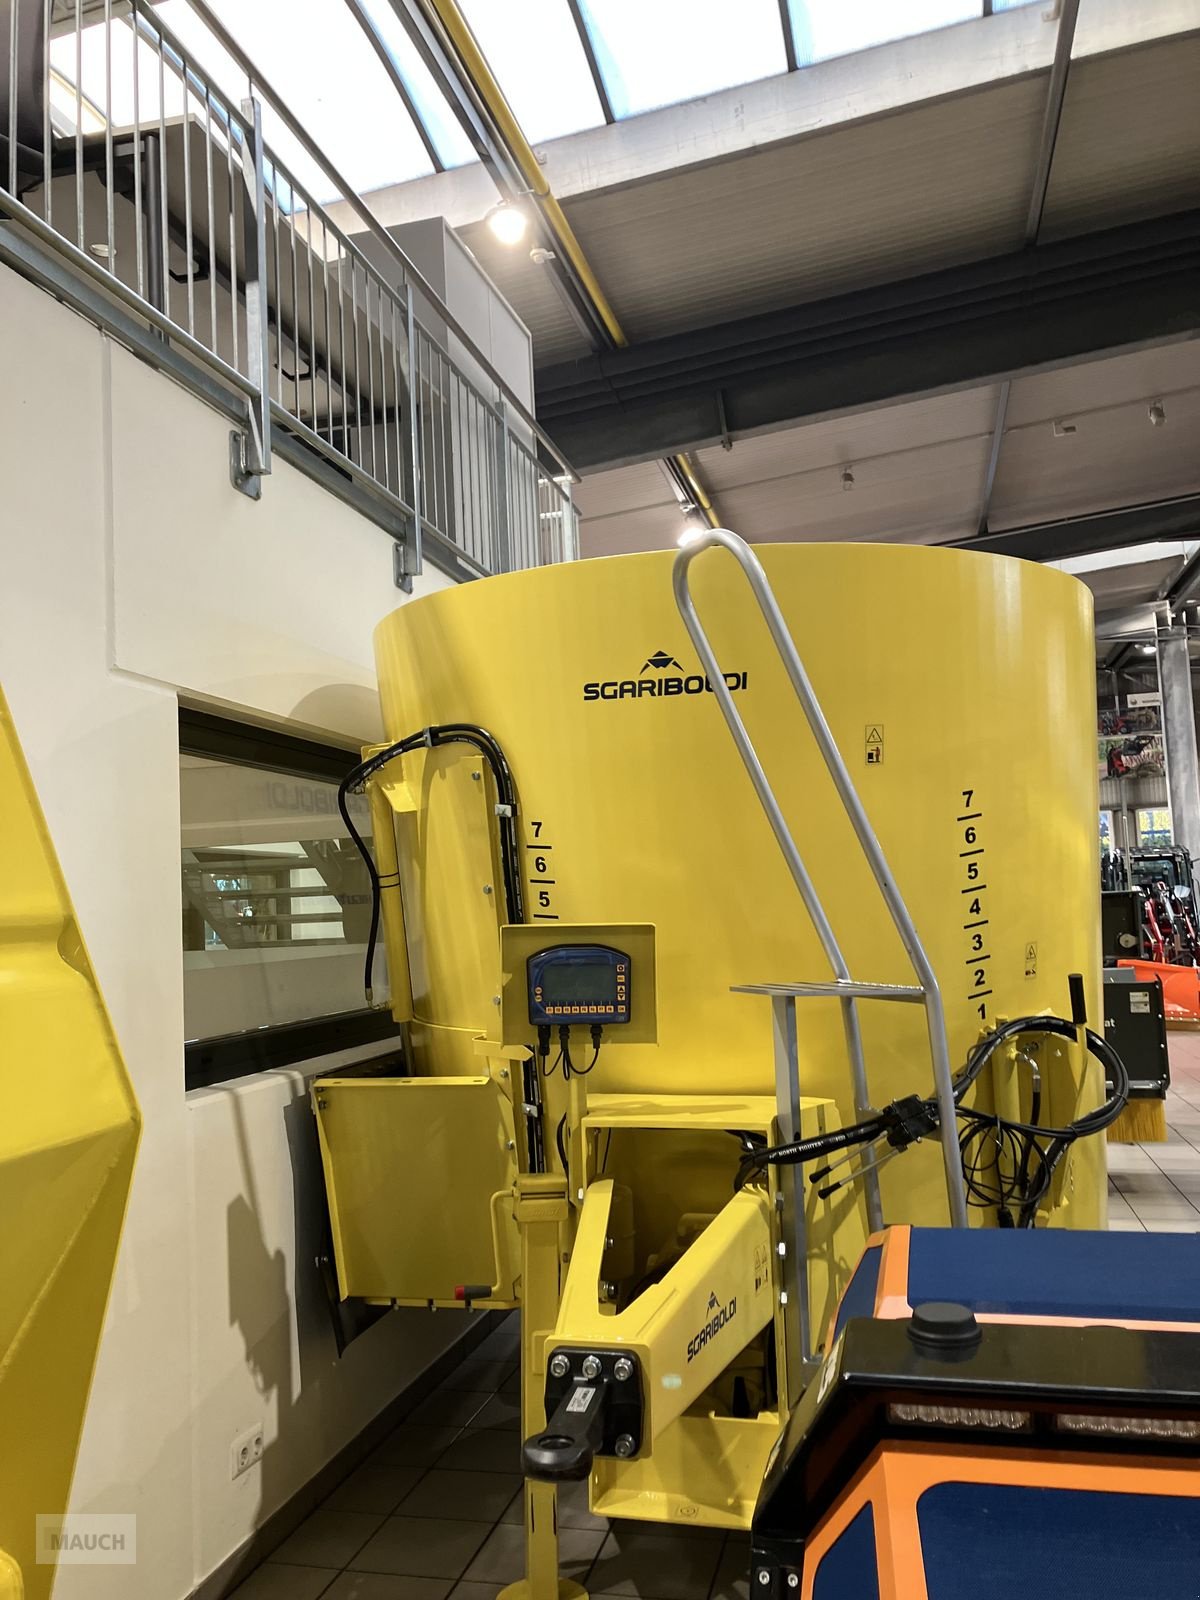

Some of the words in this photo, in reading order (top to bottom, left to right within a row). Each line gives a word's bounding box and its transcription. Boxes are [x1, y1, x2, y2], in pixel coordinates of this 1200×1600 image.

[962, 789, 974, 807] 7
[531, 822, 543, 838] 7
[964, 827, 977, 844] 6
[535, 857, 547, 873] 6
[967, 862, 979, 880] 5
[539, 891, 551, 908] 5
[969, 897, 982, 915] 4
[972, 933, 983, 951] 3
[974, 968, 986, 987] 2
[977, 1002, 986, 1020] 1
[687, 1297, 737, 1364] SGARIBOLDI
